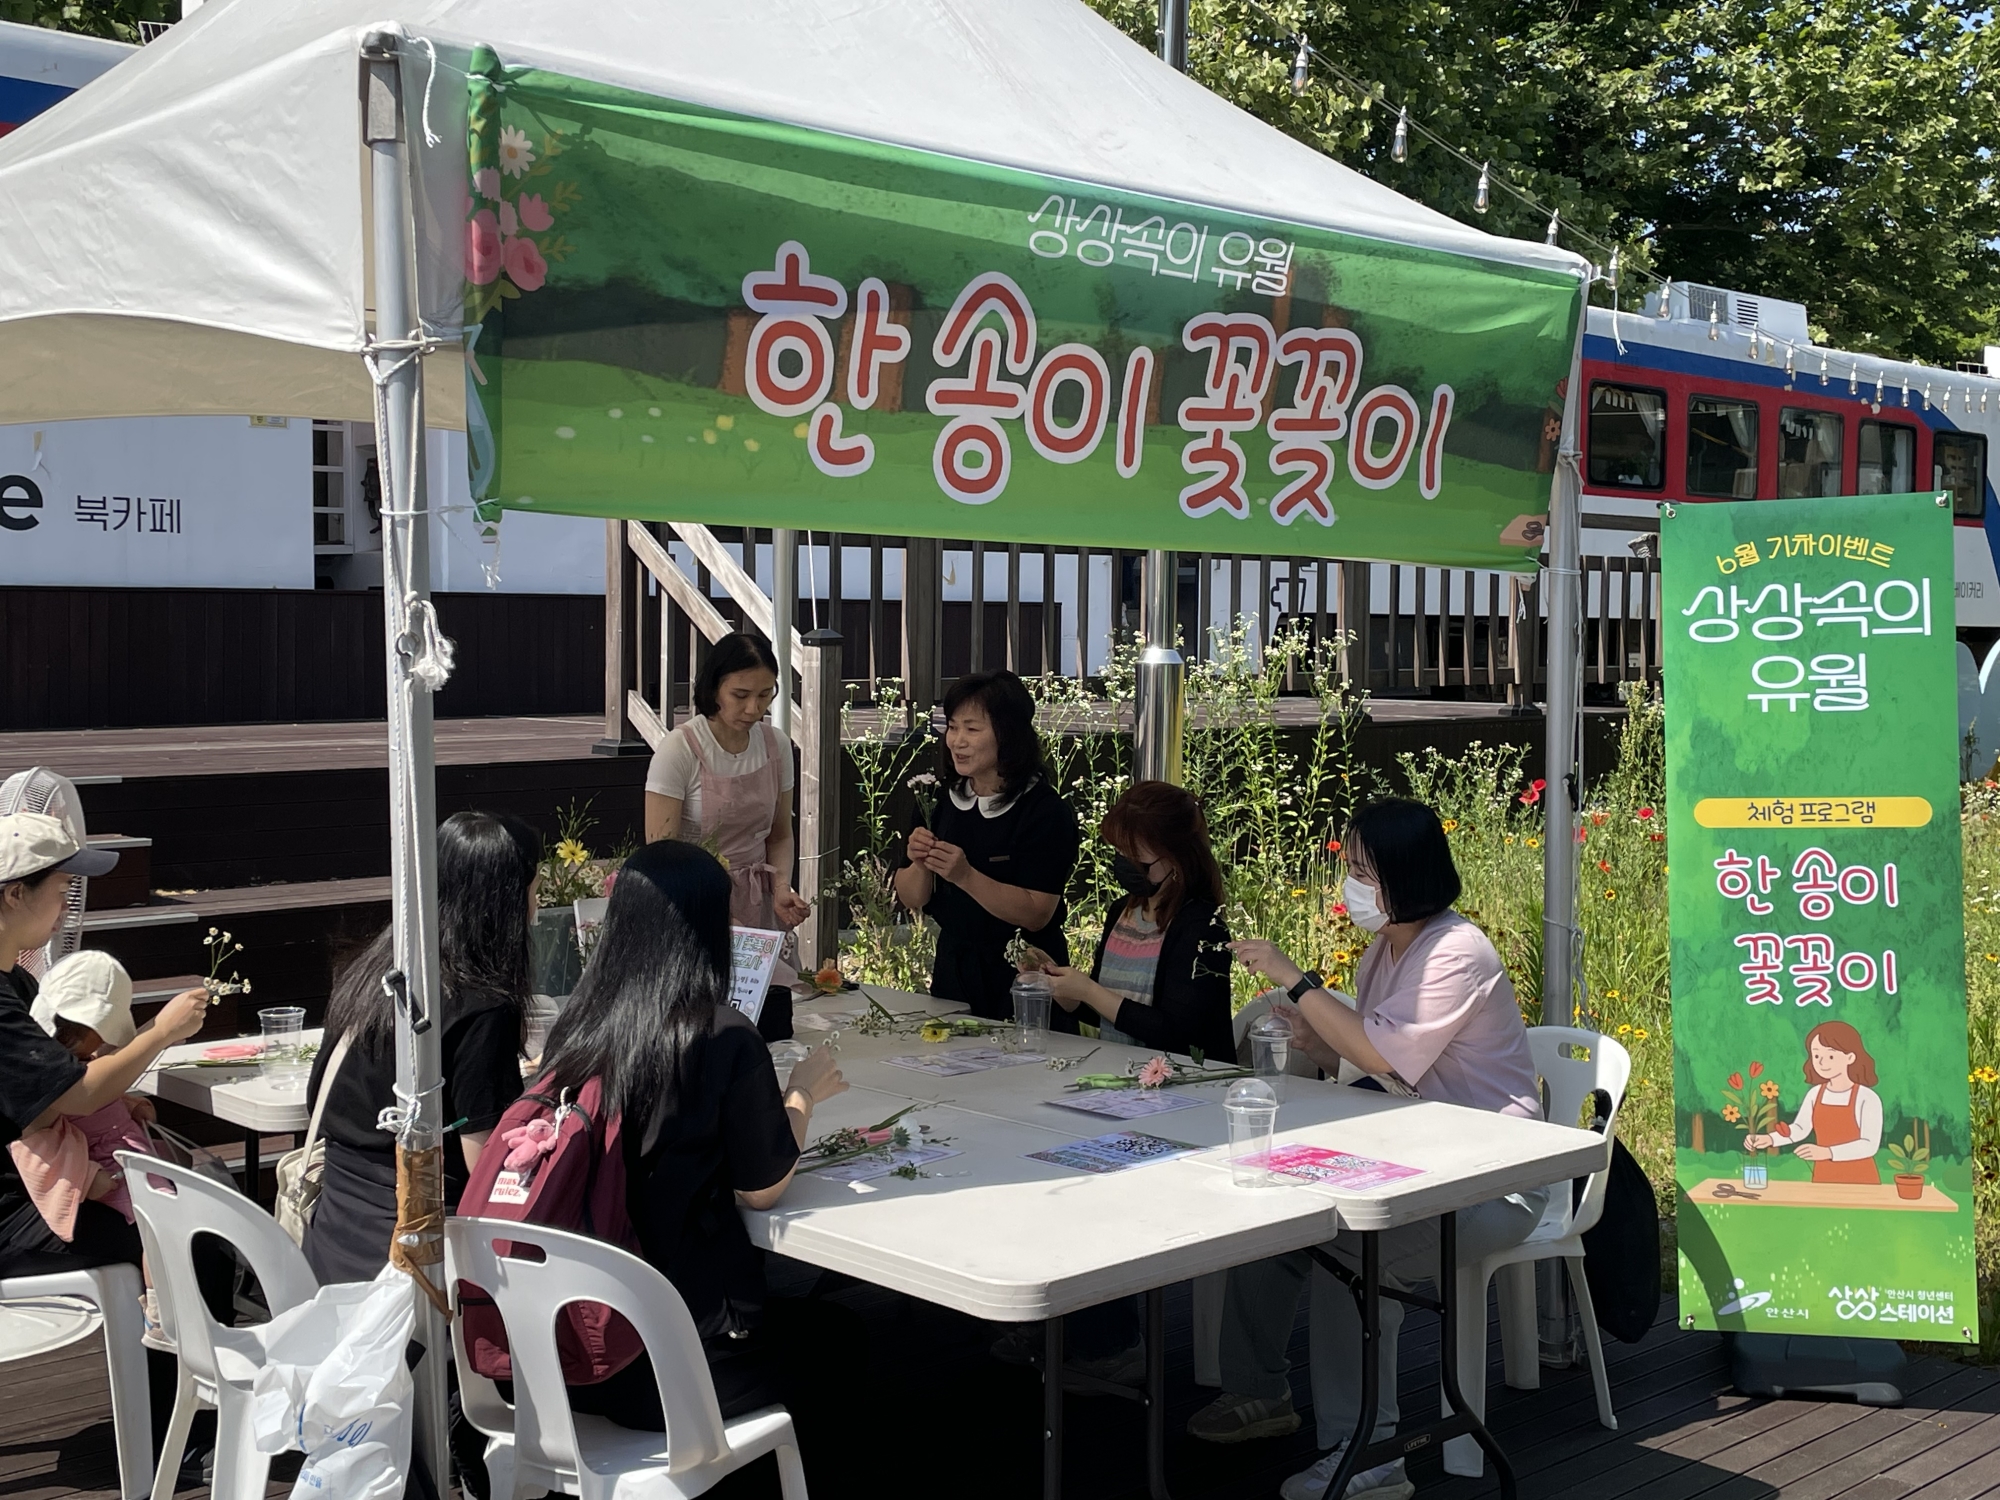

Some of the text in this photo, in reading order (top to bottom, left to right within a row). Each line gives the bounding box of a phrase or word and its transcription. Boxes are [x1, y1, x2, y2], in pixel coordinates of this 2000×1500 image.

[1027, 195, 1295, 297] 상상속의 유월
[742, 240, 1455, 527] 한 송이 꽃꽂이
[74, 495, 181, 534] 북카페
[1715, 533, 1895, 574] 6월 기차이벤트
[1681, 578, 1932, 643] 상상속의
[1747, 653, 1869, 712] 유월
[1747, 799, 1876, 825] 체험 프로그램
[1714, 847, 1899, 920] 한 송이
[1734, 932, 1898, 1007] 꽃꽂이
[1765, 1307, 1809, 1320] 안산시
[1879, 1302, 1954, 1325] 스테이션
[1887, 1289, 1954, 1302] 안산시 청년센터
